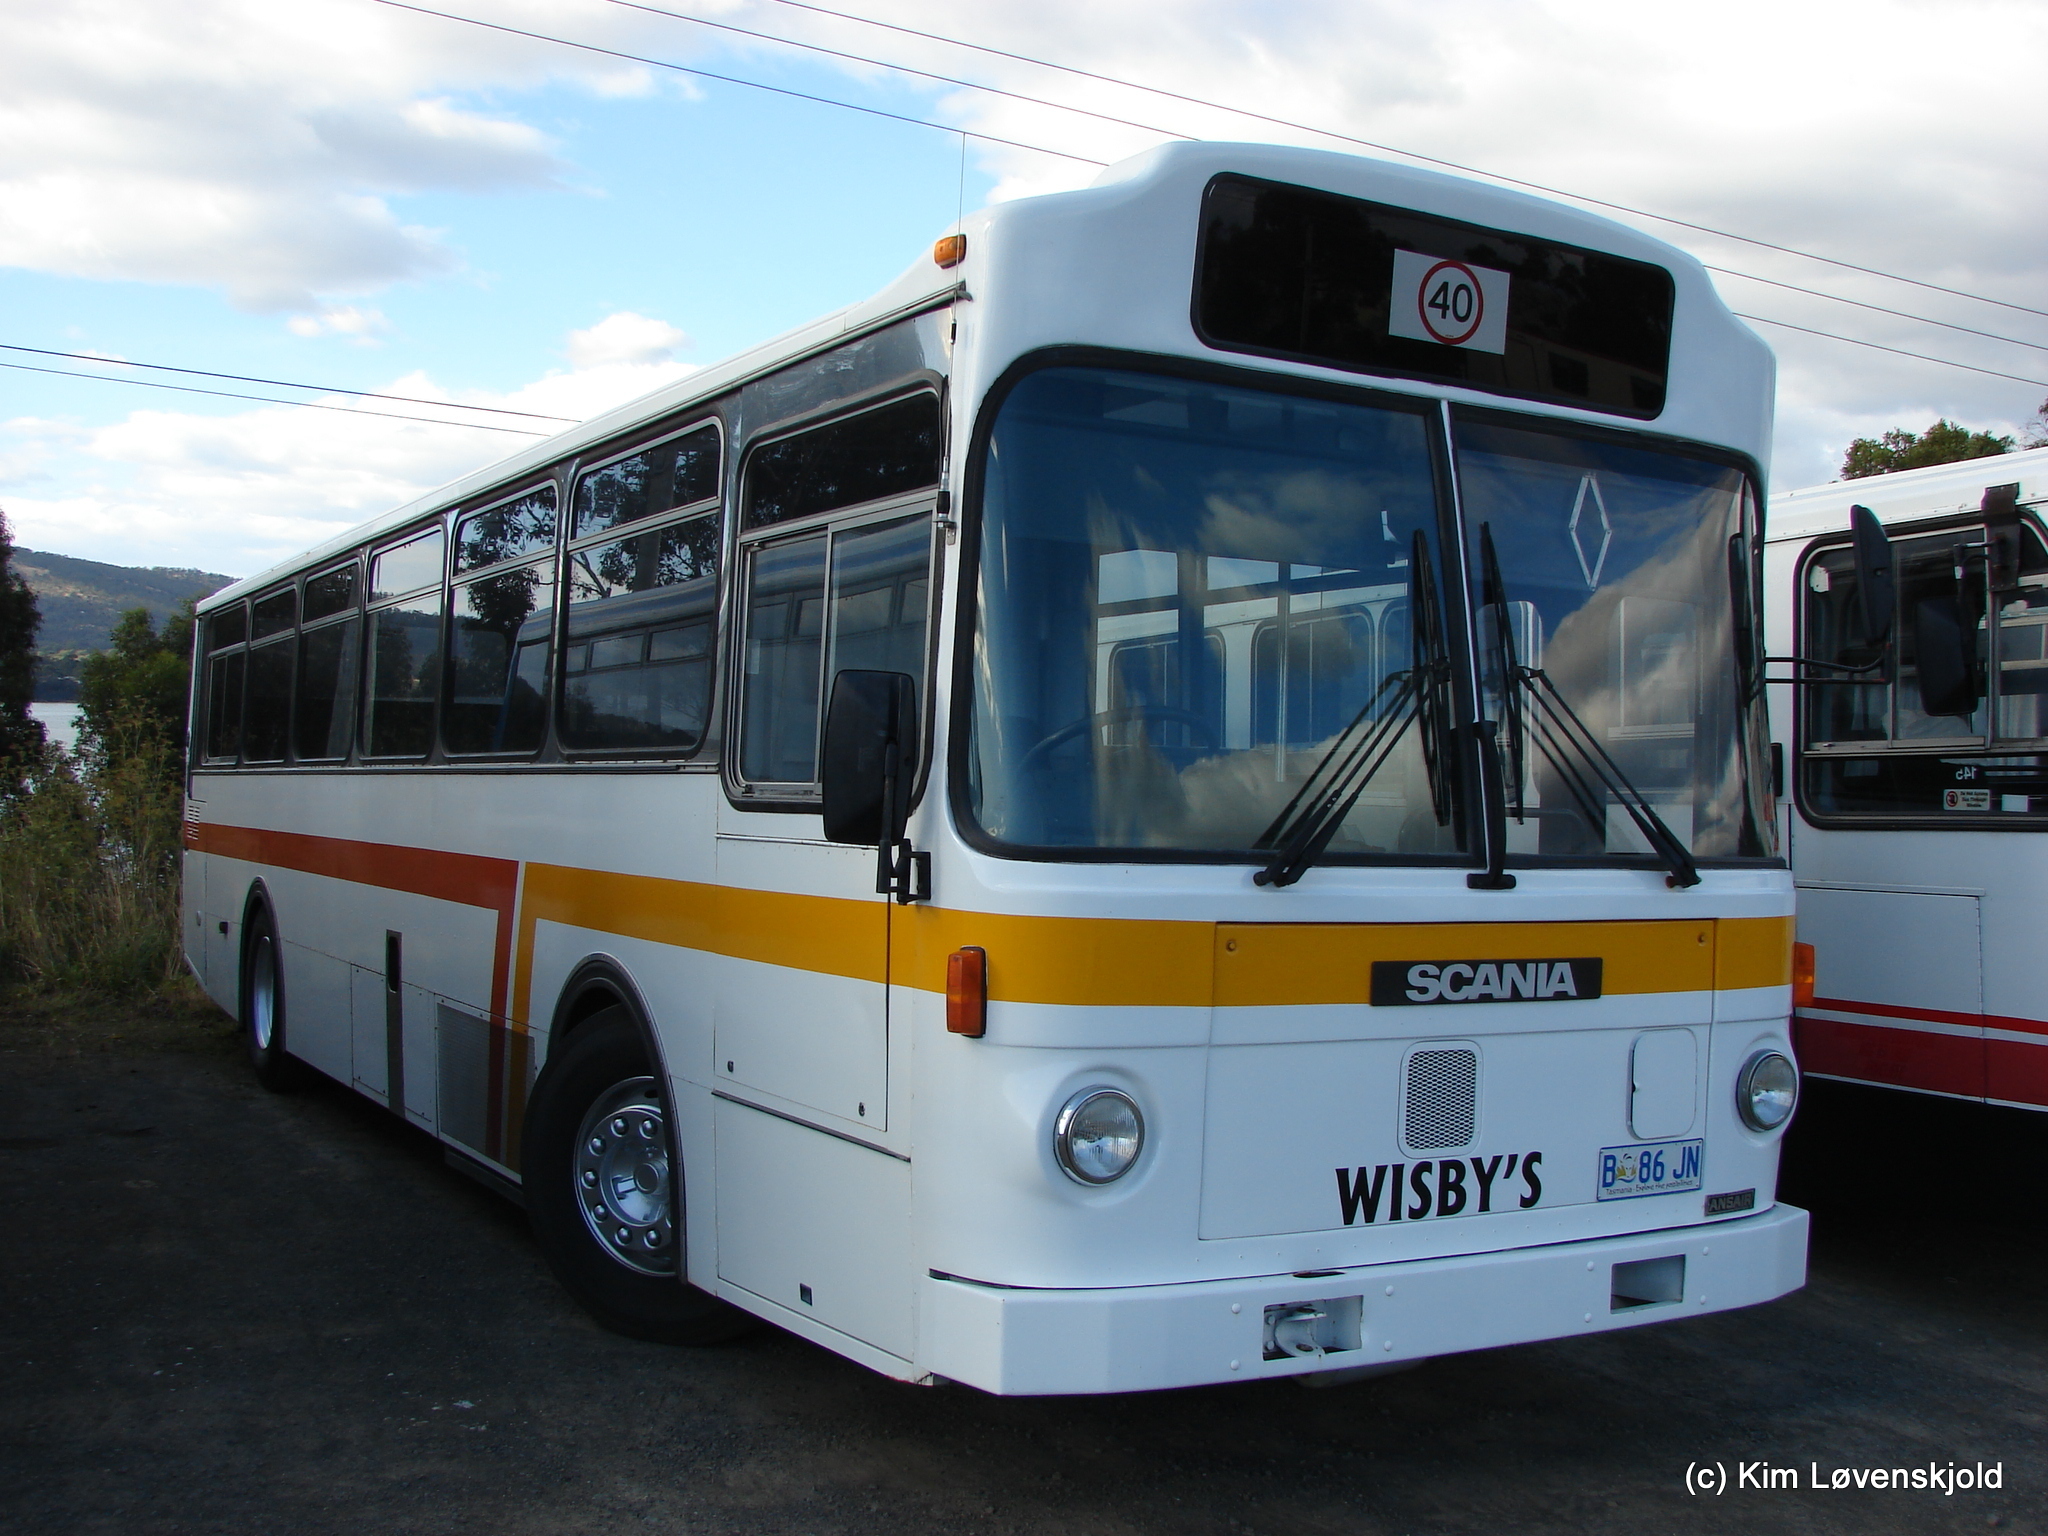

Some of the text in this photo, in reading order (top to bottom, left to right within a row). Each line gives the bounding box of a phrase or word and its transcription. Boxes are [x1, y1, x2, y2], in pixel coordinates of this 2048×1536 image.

[1428, 281, 1473, 323] 40
[1405, 962, 1578, 1002] SCANIA
[1602, 1145, 1700, 1188] B 86 JN
[1335, 1151, 1543, 1226] WISBY'S
[1605, 1185, 1633, 1196] Tasmania
[1636, 1183, 1654, 1193] Explore
[1708, 1193, 1753, 1212] ANSAIR
